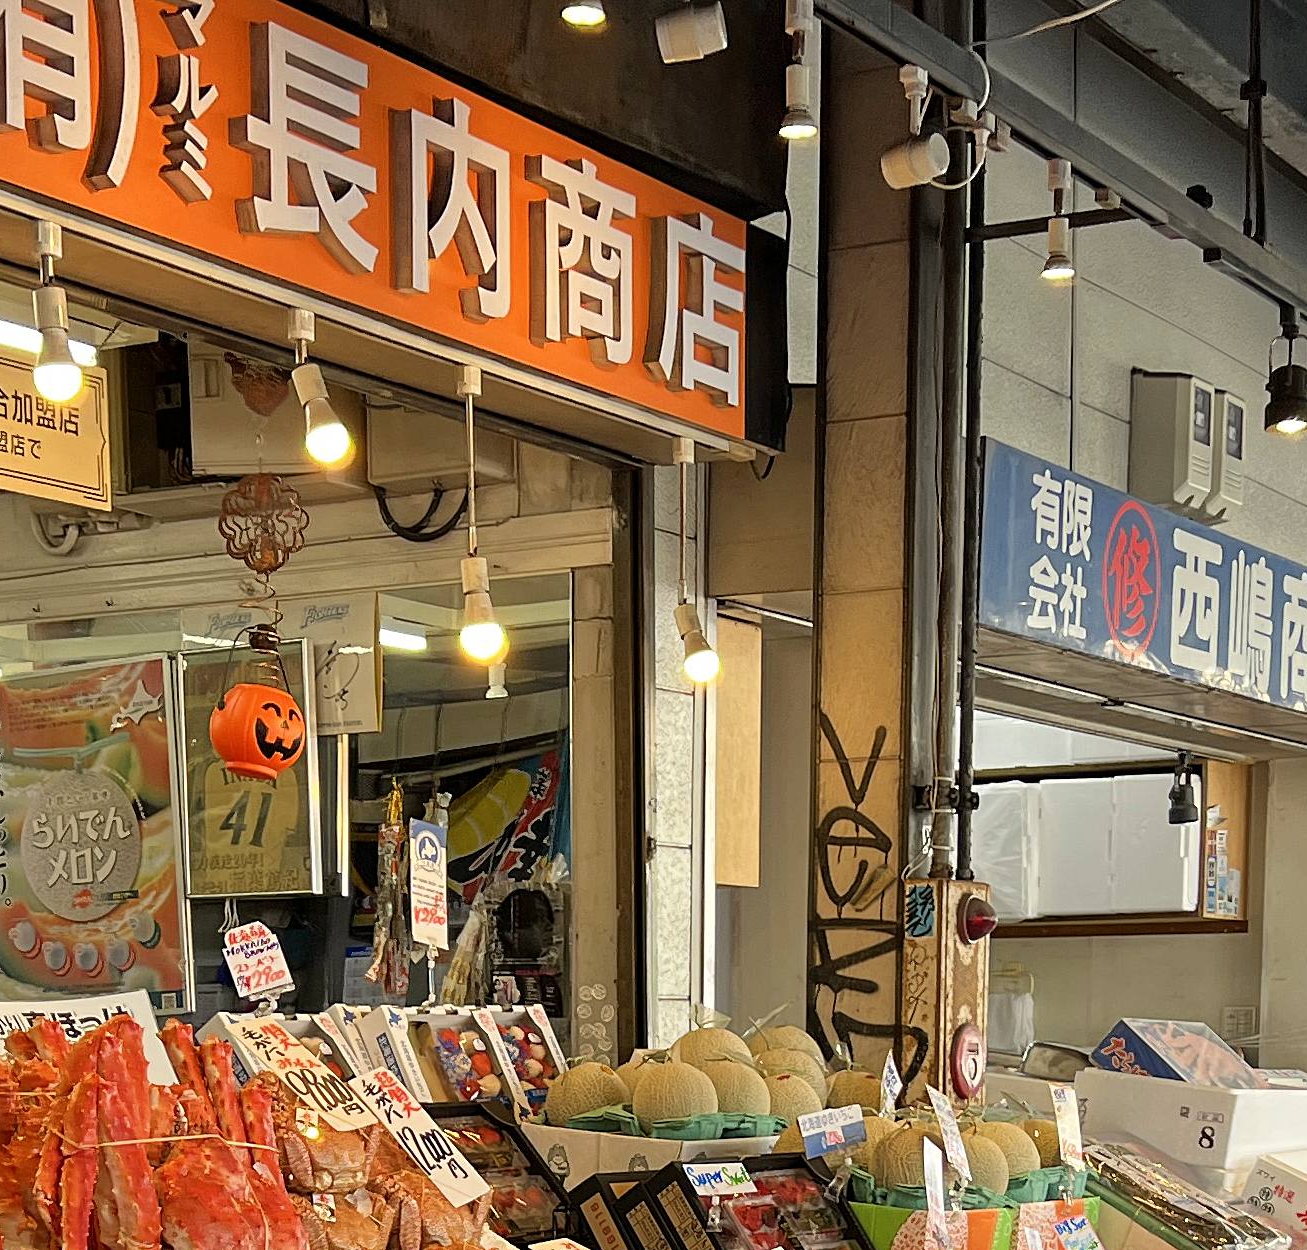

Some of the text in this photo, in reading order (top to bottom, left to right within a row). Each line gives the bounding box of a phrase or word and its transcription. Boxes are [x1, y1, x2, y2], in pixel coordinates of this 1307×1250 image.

[230, 20, 746, 408] 長内商店
[1031, 470, 1095, 562] 有限
[1026, 563, 1089, 642] 会社
[31, 804, 132, 849] らいでん
[218, 790, 275, 848] 41
[46, 847, 119, 888] メロン
[1197, 1125, 1216, 1149] 8
